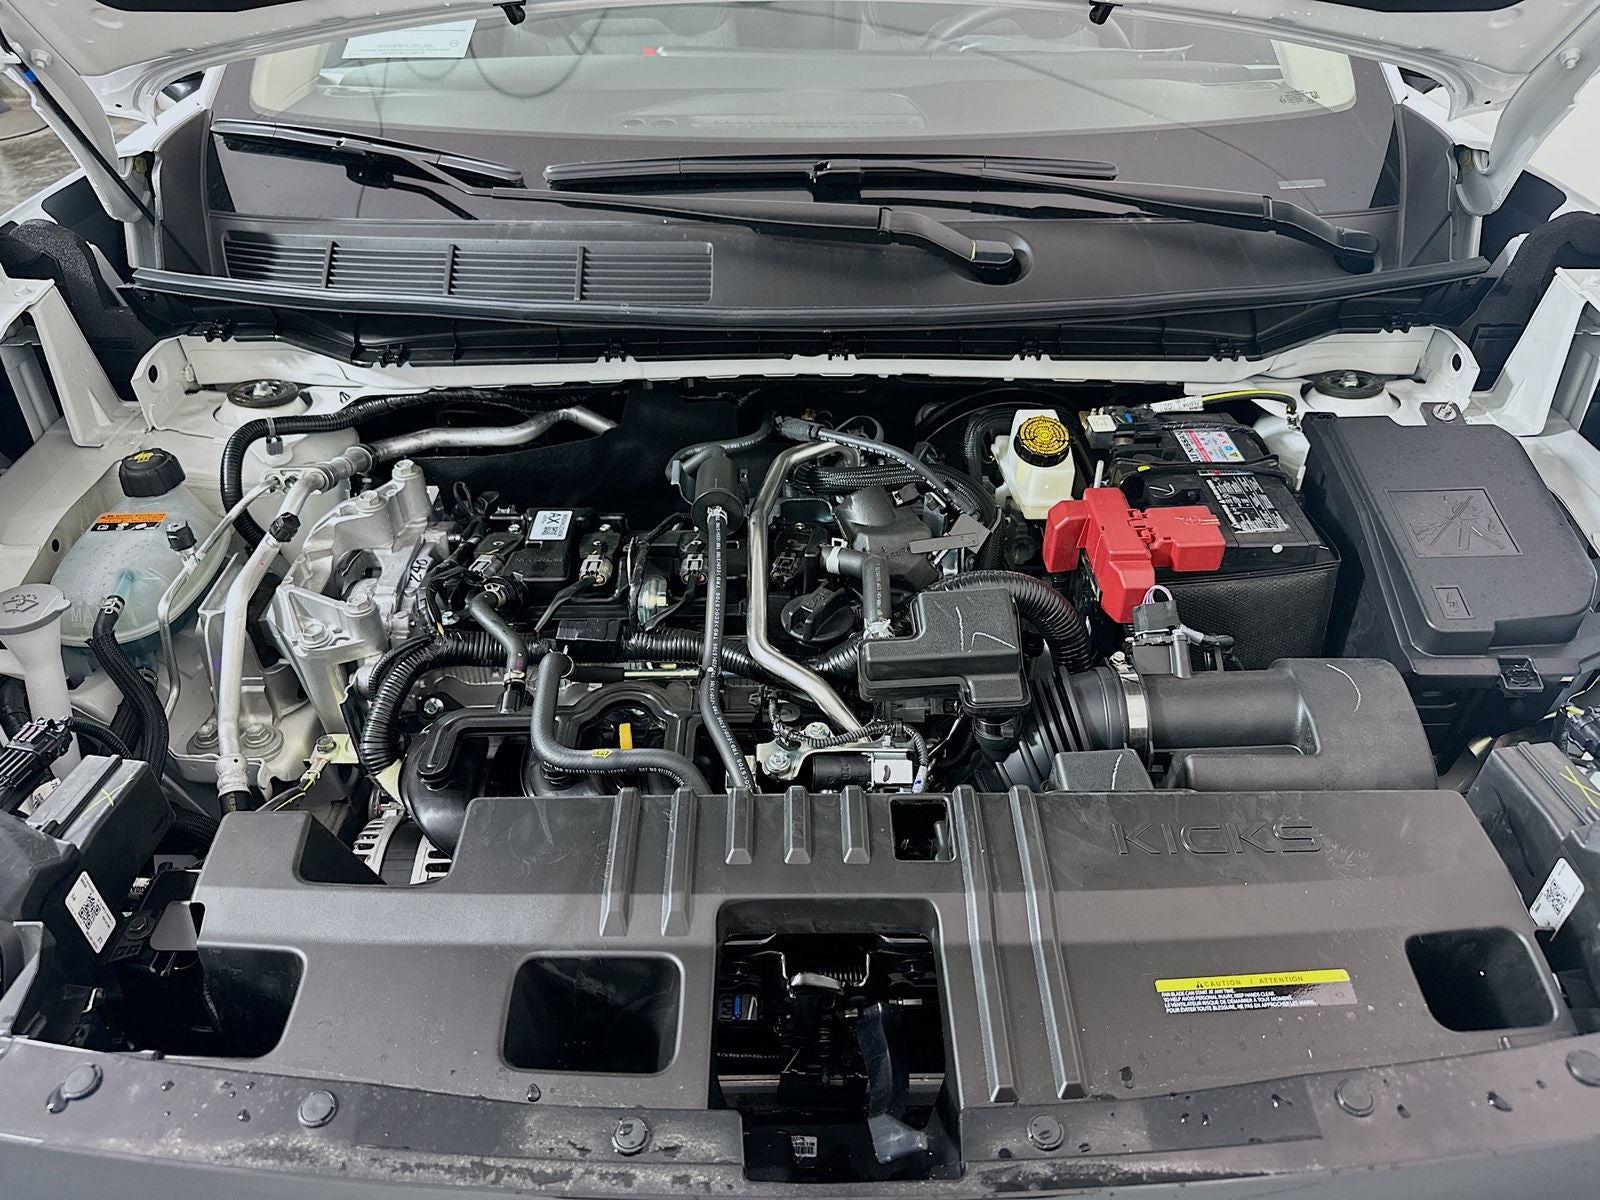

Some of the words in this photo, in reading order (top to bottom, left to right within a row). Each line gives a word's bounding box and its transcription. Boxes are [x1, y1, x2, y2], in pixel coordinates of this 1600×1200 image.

[546, 512, 561, 524] AX
[1111, 822, 1321, 855] KICKS
[1203, 979, 1241, 987] CAUTION
[1259, 975, 1304, 984] ATTENTION
